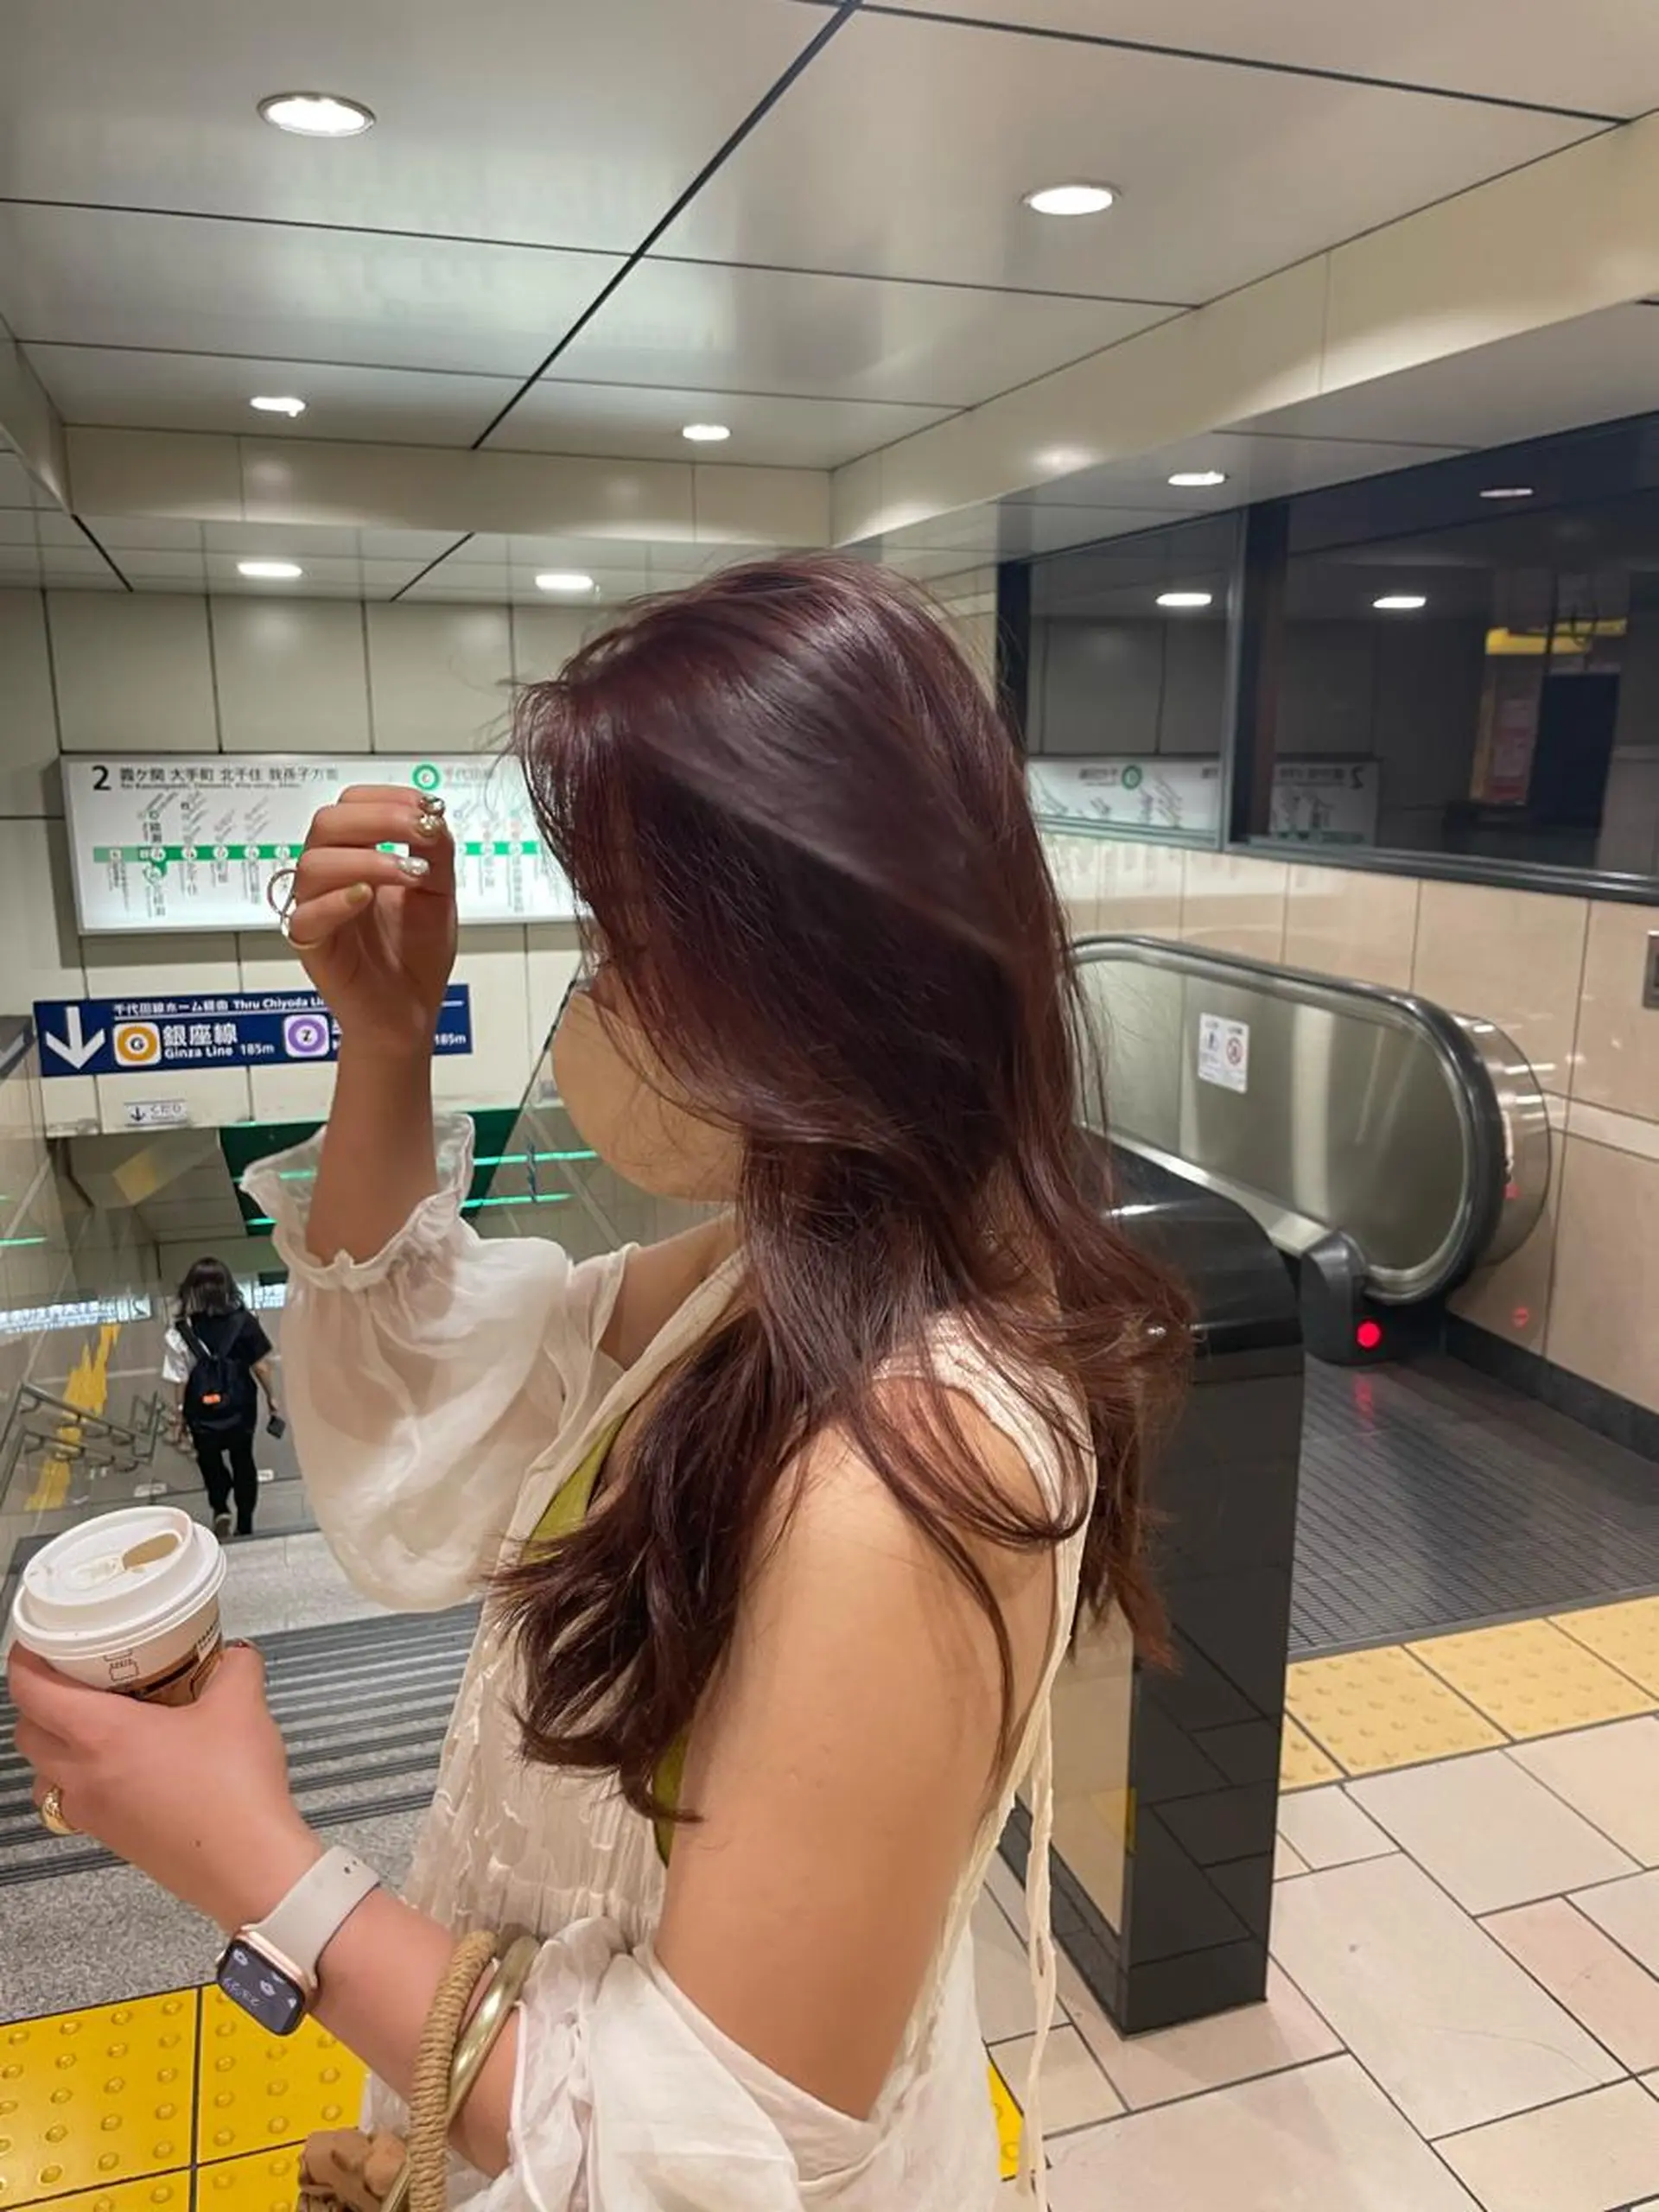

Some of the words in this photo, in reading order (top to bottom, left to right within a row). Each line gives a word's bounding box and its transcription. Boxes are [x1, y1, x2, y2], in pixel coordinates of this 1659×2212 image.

[92, 765, 111, 791] 2
[233, 1000, 259, 1009] Thru
[262, 996, 308, 1011] Chiyoda
[163, 1023, 238, 1046] 銀座線
[164, 1047, 203, 1059] Ginza
[206, 1045, 233, 1058] Line
[240, 1043, 275, 1056] 185m
